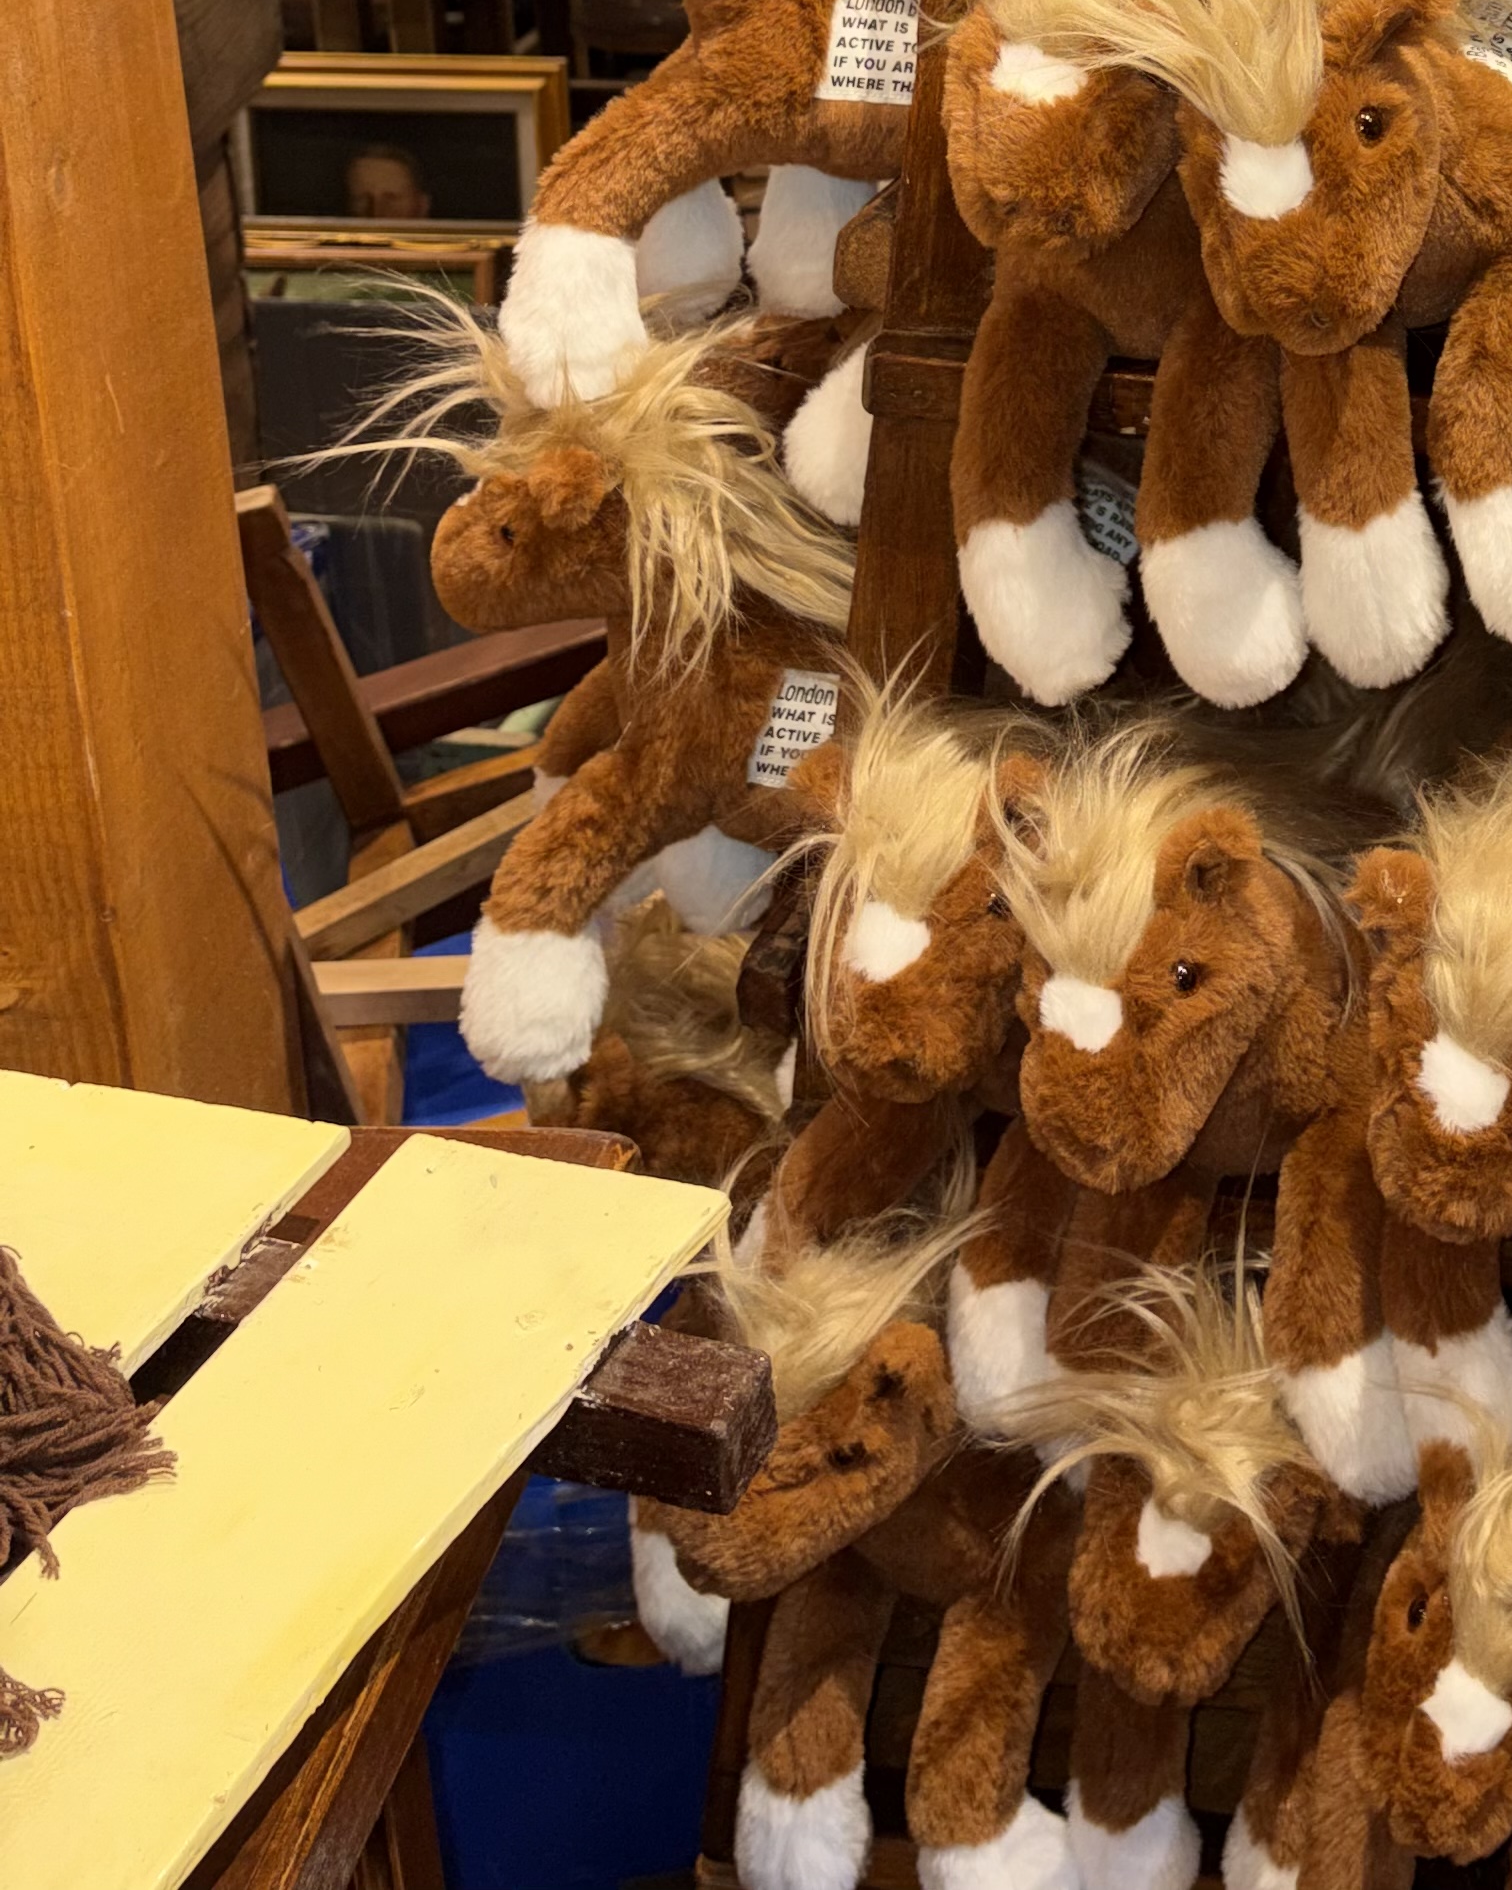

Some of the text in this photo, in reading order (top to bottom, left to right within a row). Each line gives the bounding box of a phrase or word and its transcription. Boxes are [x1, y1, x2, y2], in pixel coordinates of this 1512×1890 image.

[842, 16, 909, 34] WHAT IS
[836, 36, 895, 52] ACTIVE
[833, 55, 848, 68] IF
[855, 57, 886, 71] YOU
[831, 75, 885, 91] WHERE
[1105, 528, 1133, 549] ANY
[771, 706, 836, 726] WHAT IS
[764, 726, 821, 744] ACTIVE
[759, 744, 775, 757] IF
